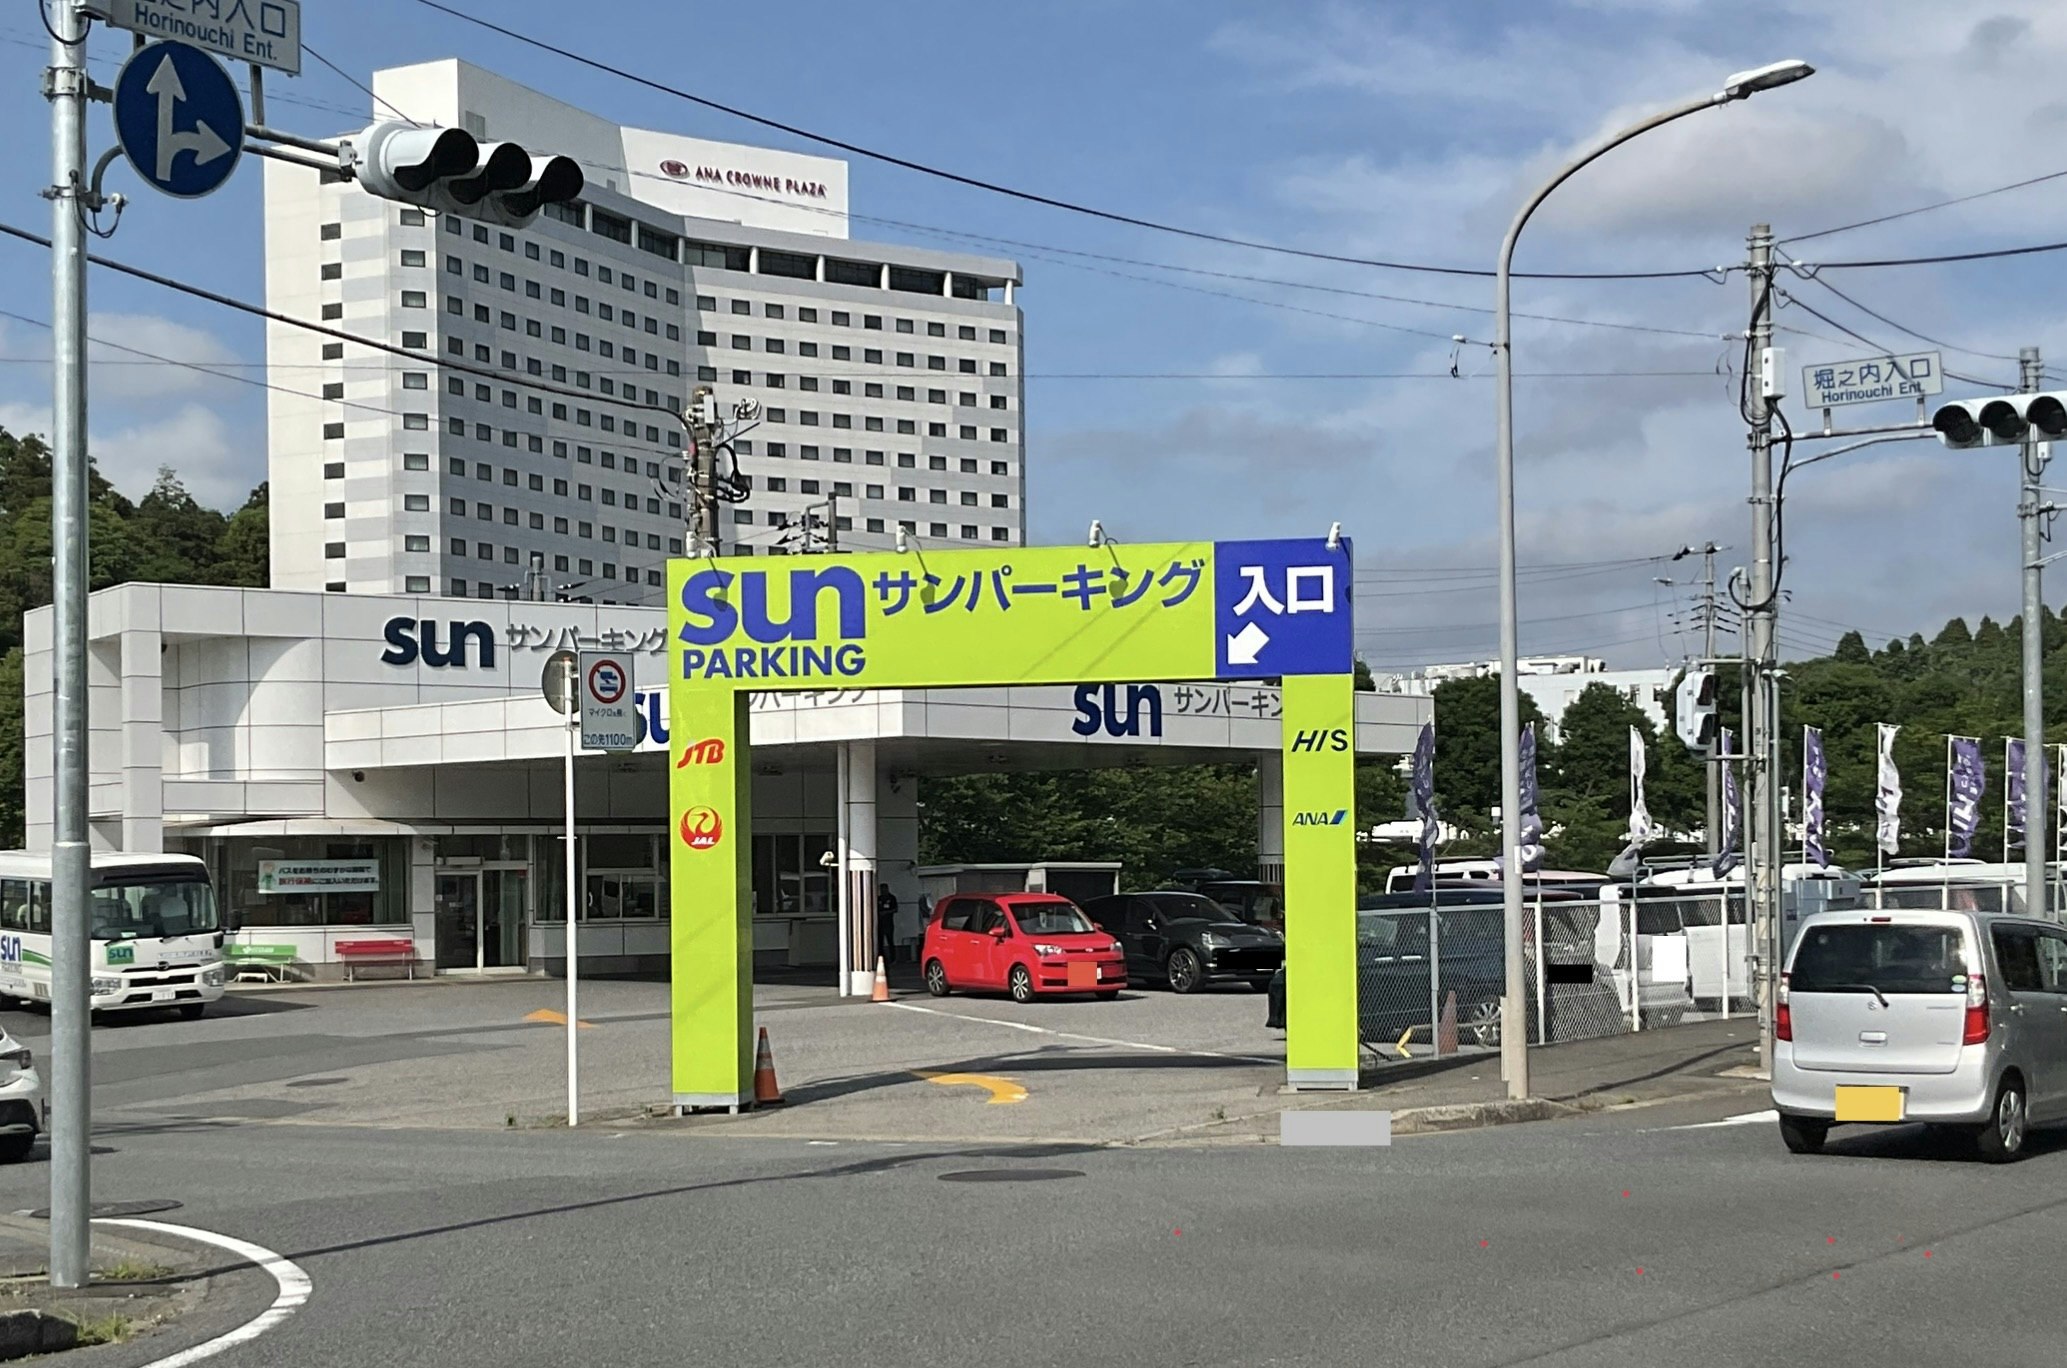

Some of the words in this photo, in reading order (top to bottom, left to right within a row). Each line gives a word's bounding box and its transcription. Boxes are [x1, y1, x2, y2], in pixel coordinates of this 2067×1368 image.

[135, 2, 234, 49] Horinouchi
[244, 33, 278, 61] Ent.
[695, 165, 723, 183] ANA
[726, 170, 780, 191] CROWNE
[785, 178, 826, 198] PLAZA
[1814, 357, 1931, 390] 堀之内入口
[1822, 386, 1893, 403] Horinouchi
[1899, 381, 1926, 395] Ent.
[873, 557, 1206, 615] サンパーキング
[1233, 566, 1335, 618] 入口
[679, 565, 867, 646] sun
[380, 616, 496, 669] sun
[505, 623, 668, 655] サンパーキング
[683, 644, 867, 680] PARKING
[1072, 684, 1163, 738] sun
[677, 738, 725, 769] JTB
[1291, 729, 1348, 752] HIS
[1292, 812, 1329, 826] ANA
[691, 836, 716, 846] JAL
[1, 935, 22, 962] sun
[109, 947, 134, 960] sun
